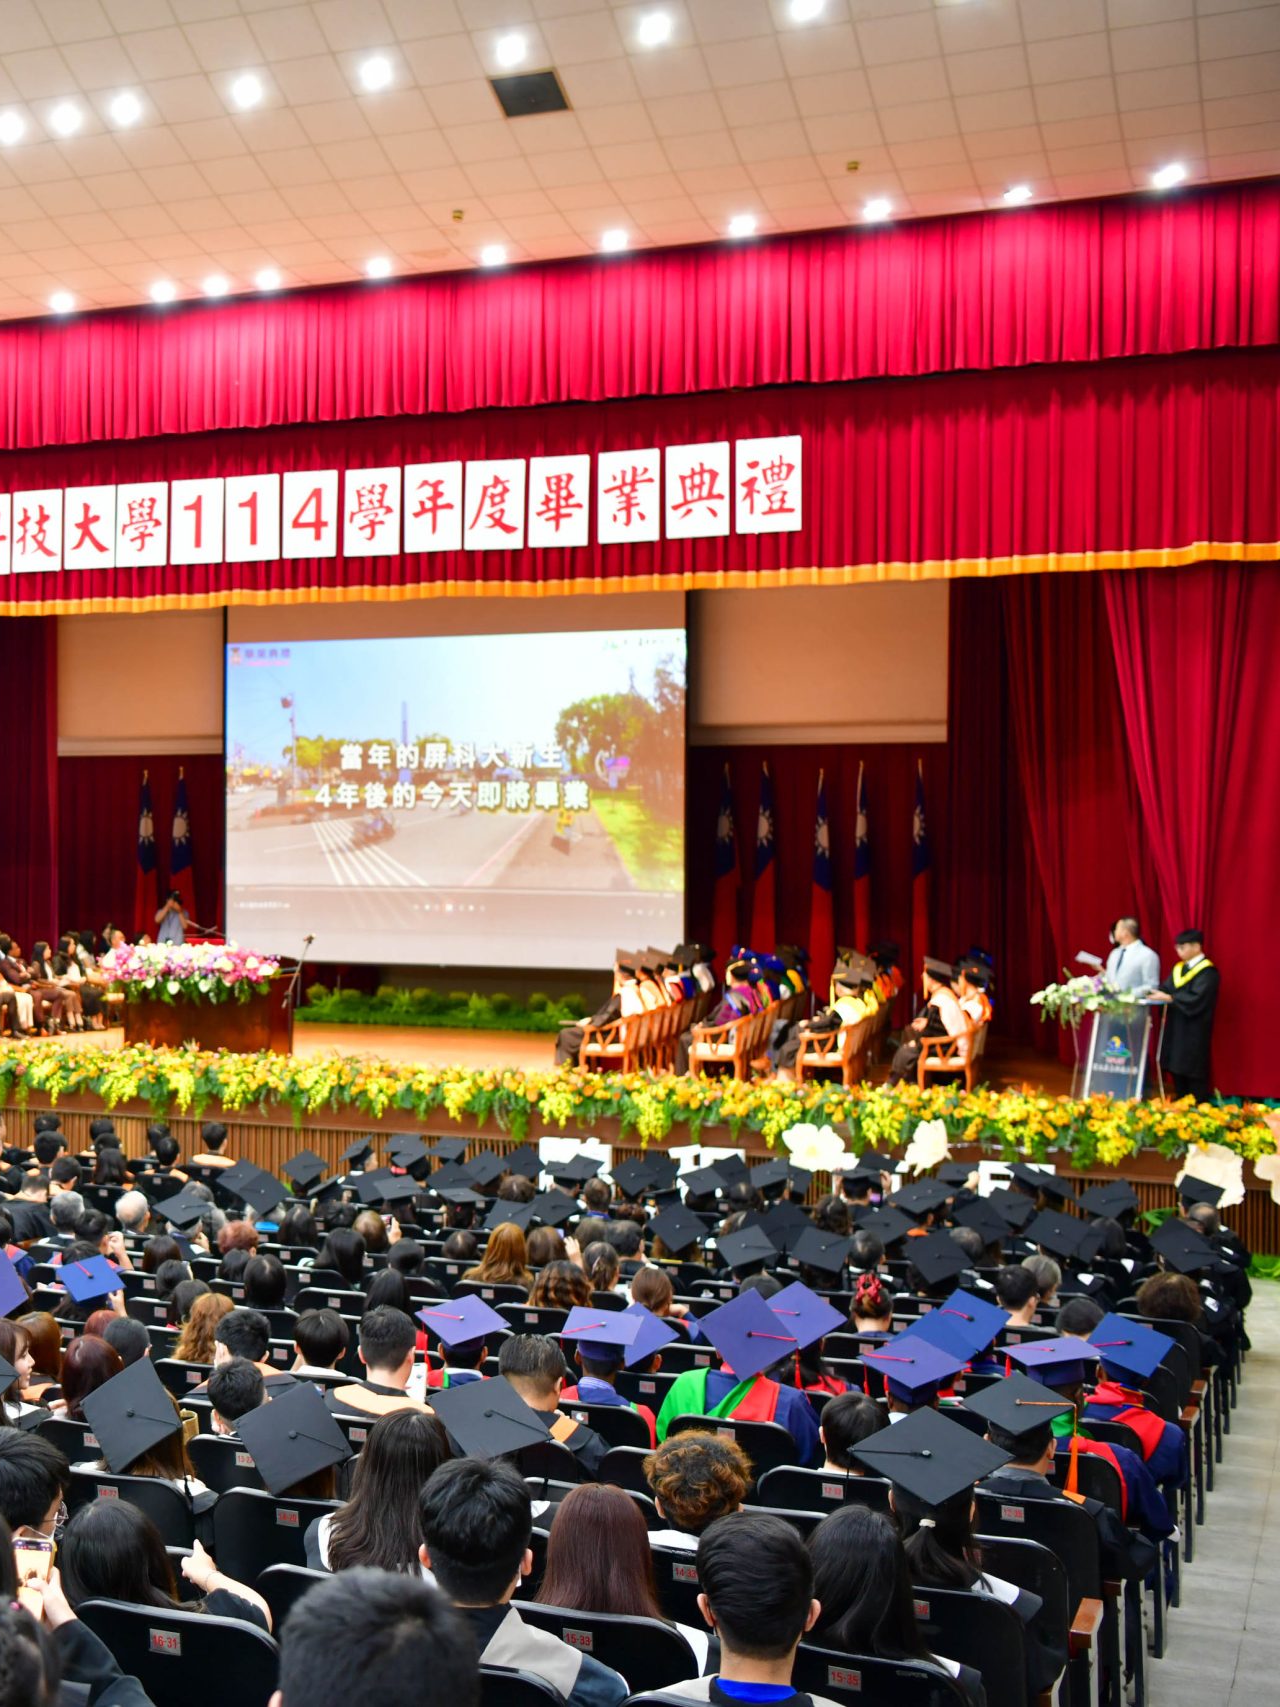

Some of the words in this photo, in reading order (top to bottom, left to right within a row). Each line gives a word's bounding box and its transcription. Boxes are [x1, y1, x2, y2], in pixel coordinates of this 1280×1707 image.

[340, 743, 563, 770] 當年的屏科大新生
[314, 781, 589, 809] 4年後的今天即將畢業
[153, 1633, 177, 1649] 16-31
[565, 1632, 591, 1646] 15-33
[831, 1671, 859, 1686] 15-35
